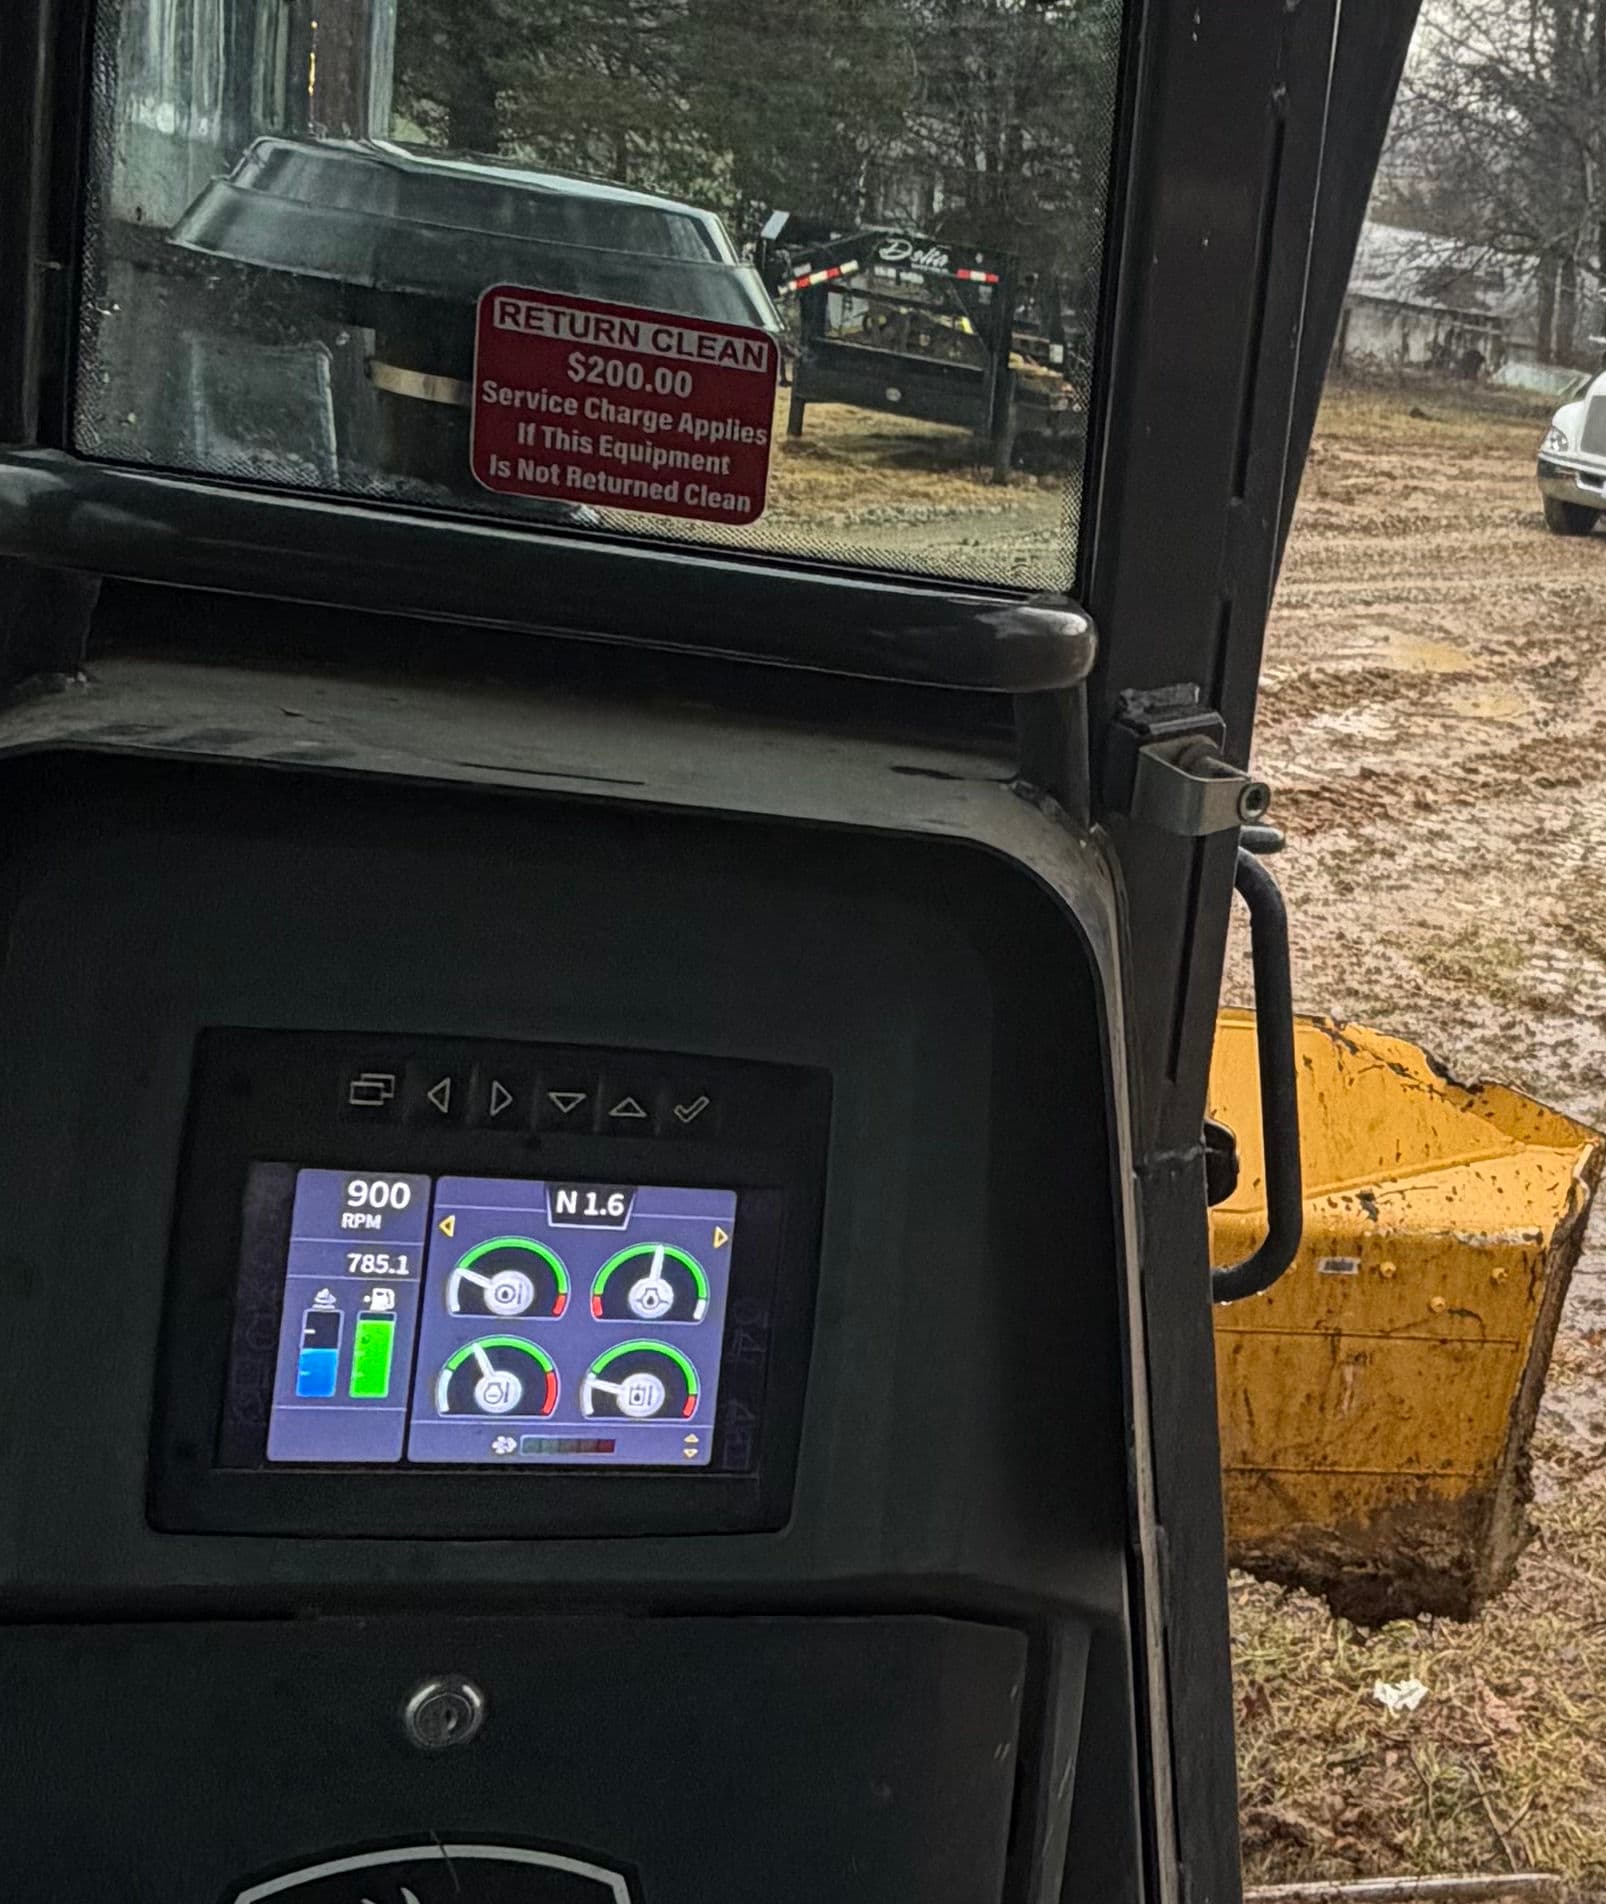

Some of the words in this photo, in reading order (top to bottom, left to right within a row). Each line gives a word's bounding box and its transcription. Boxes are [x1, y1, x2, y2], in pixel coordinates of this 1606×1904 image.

[879, 238, 949, 267] Delta
[500, 301, 640, 347] RETURN
[651, 328, 765, 369] CLEAN
[567, 352, 692, 396] $200.00
[482, 380, 577, 415] Service
[584, 397, 673, 433] Charge
[678, 412, 767, 445] Applies
[518, 423, 535, 444] If
[541, 425, 592, 454] This
[599, 435, 730, 475] Equipment
[489, 454, 510, 477] Is
[517, 458, 560, 485] Not
[566, 466, 678, 502] Returned
[684, 483, 751, 512] Clean
[347, 1180, 411, 1208] 900
[556, 1190, 577, 1214] N
[584, 1192, 625, 1216] 1.6
[341, 1213, 381, 1229] RPM
[347, 1253, 409, 1275] 785.1
